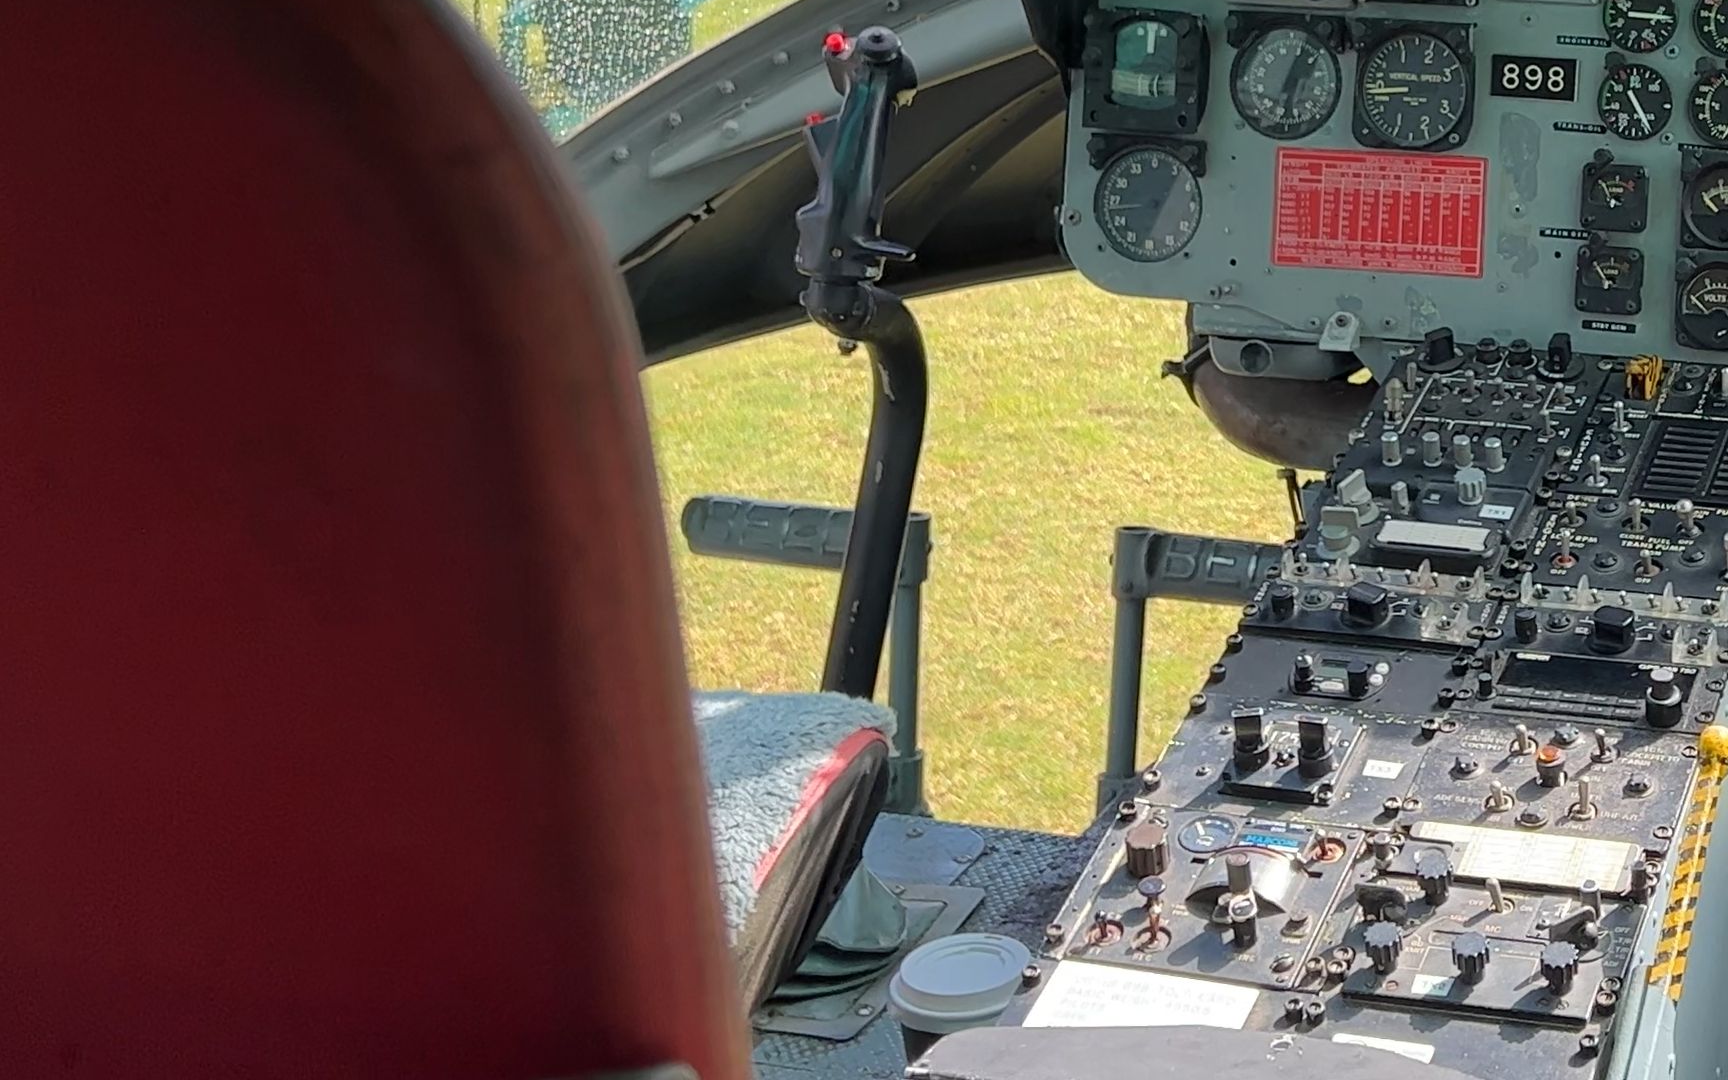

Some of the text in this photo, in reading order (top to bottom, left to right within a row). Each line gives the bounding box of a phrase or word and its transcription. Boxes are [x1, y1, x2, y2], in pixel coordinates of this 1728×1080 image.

[1424, 50, 1434, 64] 2
[1389, 72, 1418, 81] VERTICAL
[1443, 68, 1452, 83] 3
[1502, 63, 1564, 93] 898
[1440, 99, 1450, 114] 3
[1420, 115, 1430, 130] 2
[1114, 215, 1126, 227] 24
[1621, 540, 1686, 552] TRANS PUMP
[1648, 536, 1671, 546] FUEL
